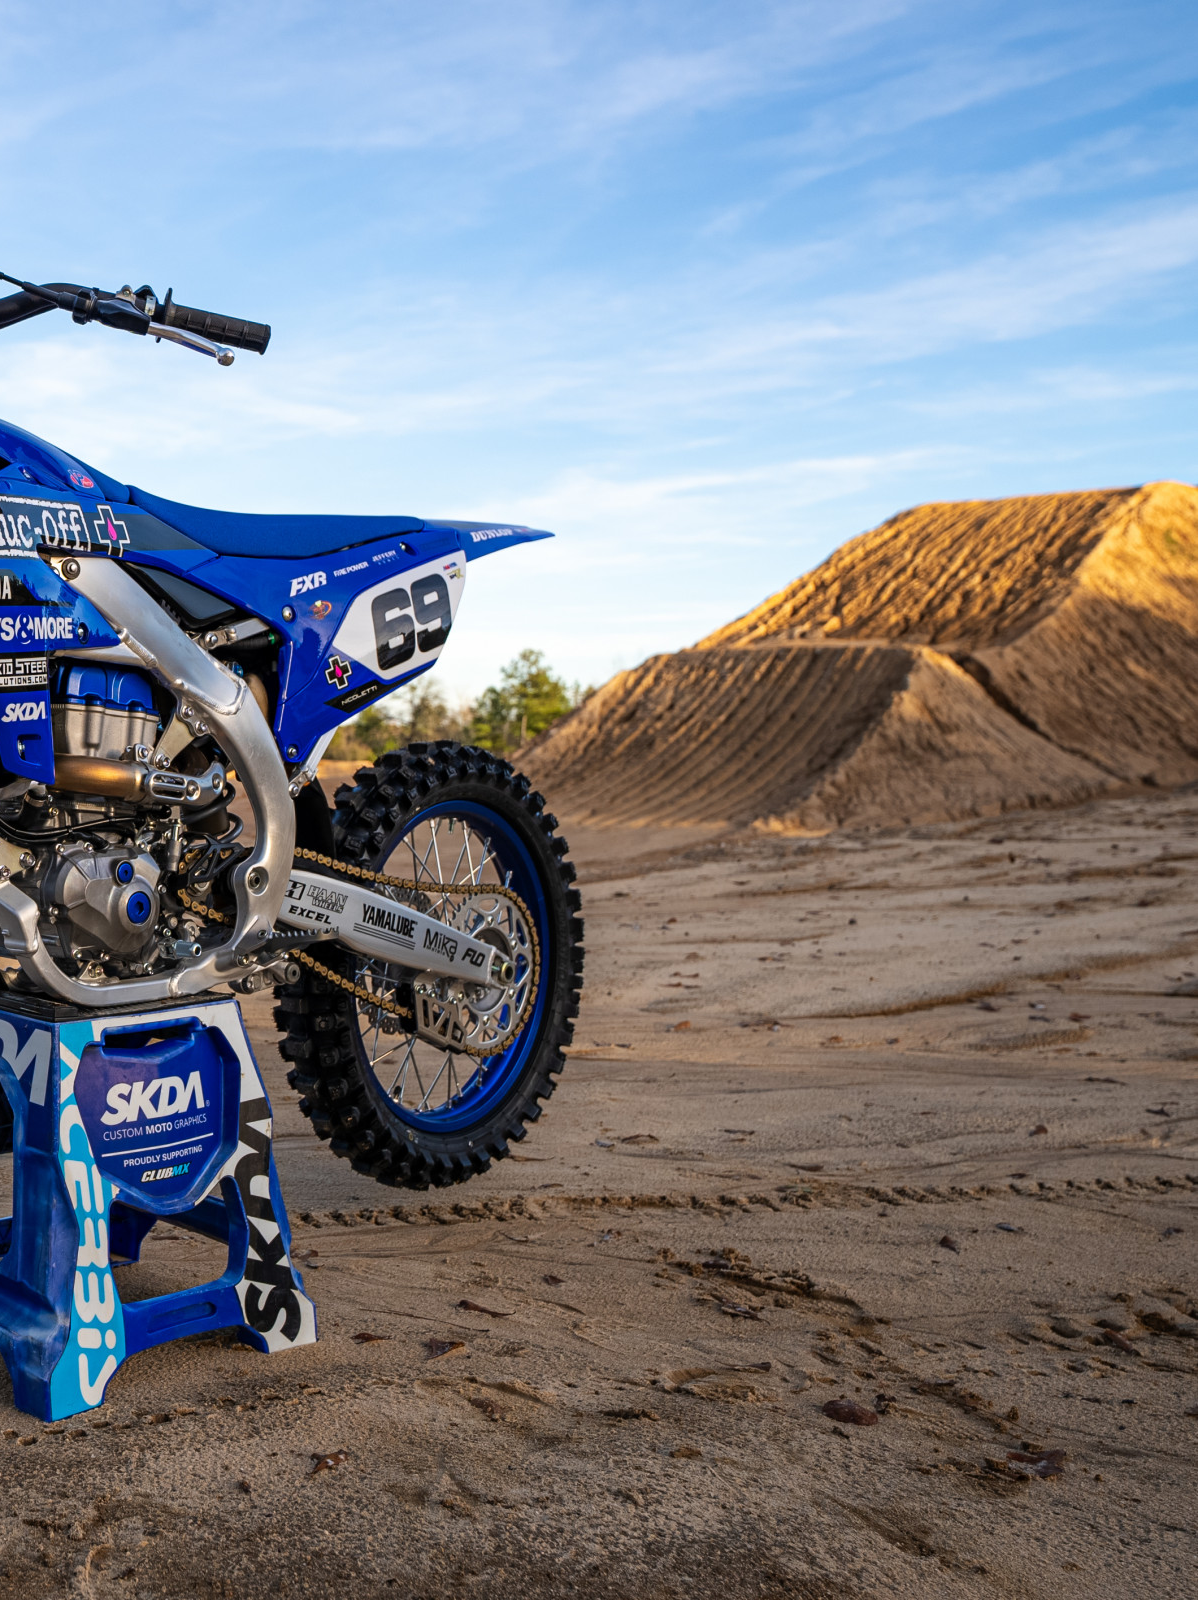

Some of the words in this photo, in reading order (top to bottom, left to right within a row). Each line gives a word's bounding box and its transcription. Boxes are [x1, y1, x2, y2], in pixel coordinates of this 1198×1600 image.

[470, 528, 514, 543] DUNLOP
[289, 570, 327, 597] FXR
[371, 573, 452, 671] 69
[15, 656, 47, 674] STEER
[1, 701, 46, 722] SKDA
[307, 885, 348, 906] HAAN
[288, 905, 331, 925] EXCEL
[362, 903, 417, 939] YAMALUBE
[100, 1070, 205, 1126] SKDA
[103, 1127, 143, 1141] CUSTOM
[145, 1122, 173, 1135] MOTO
[174, 1113, 207, 1130] GRAPHICS
[123, 1154, 161, 1168] PROUDLY
[162, 1145, 203, 1161] SUPPORTING
[141, 1162, 191, 1183] CLUBMX
